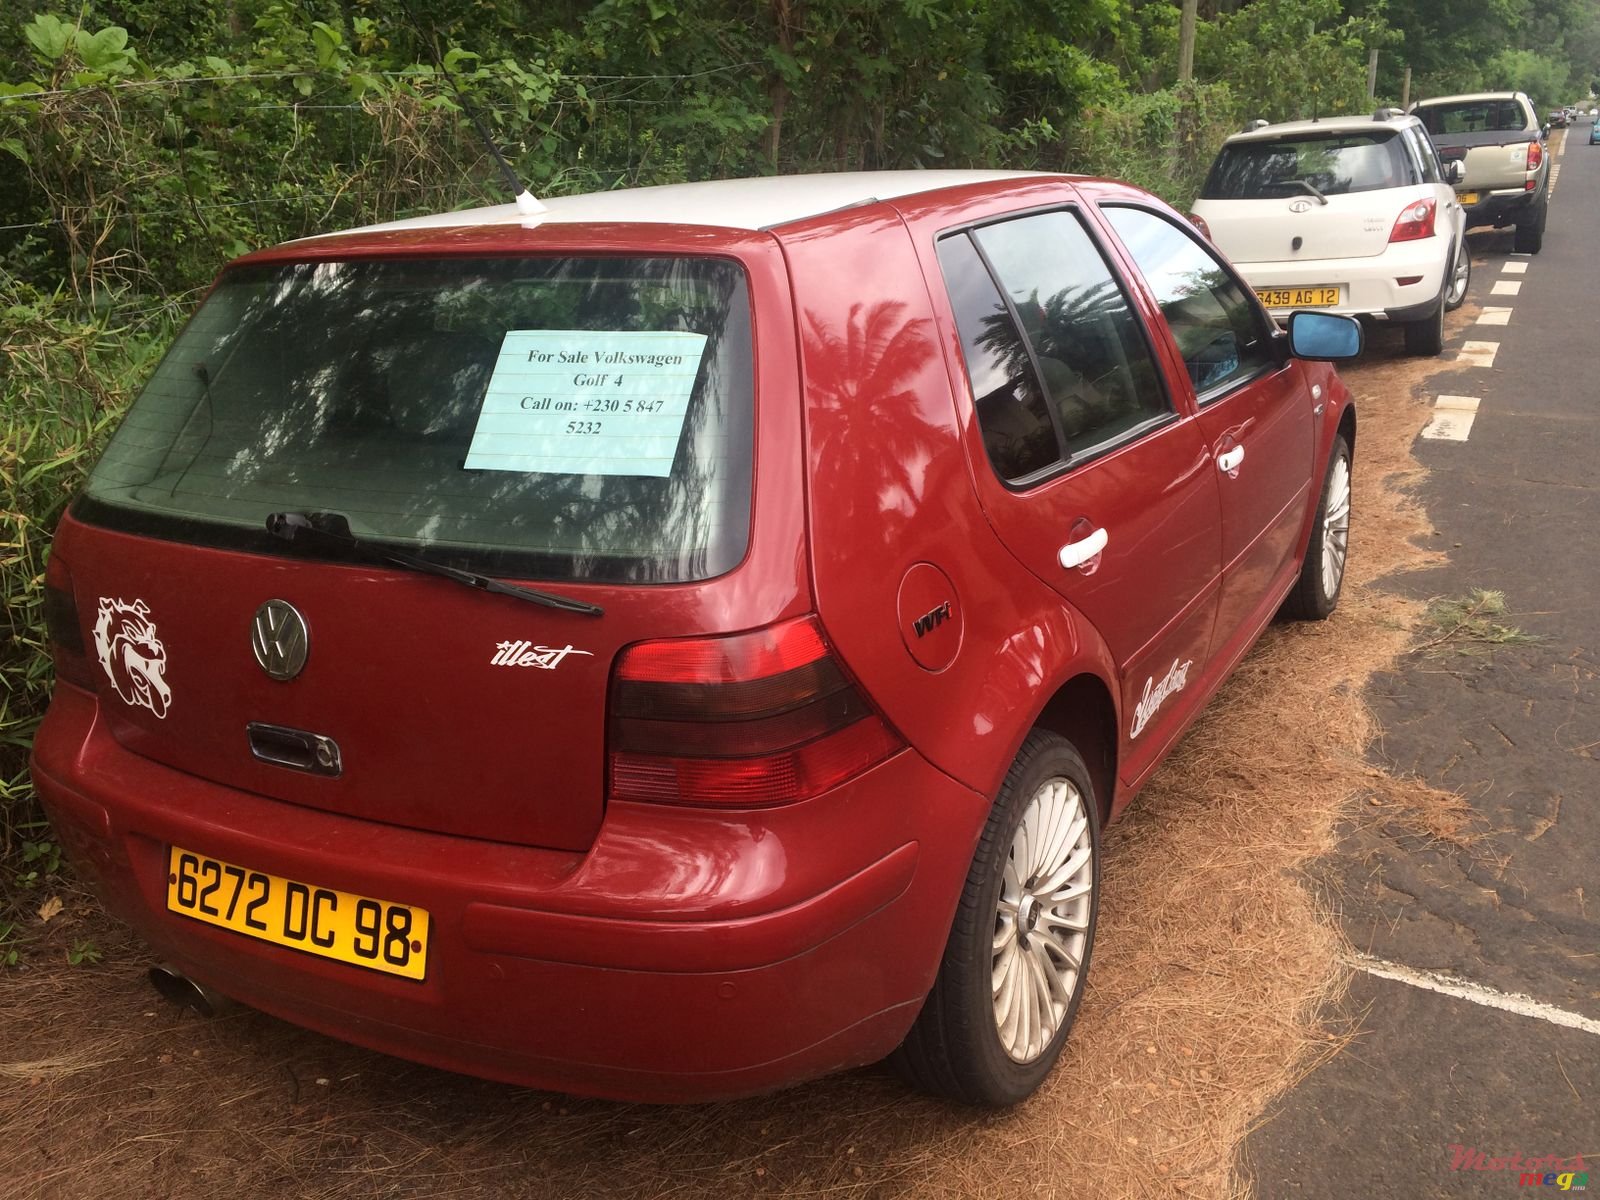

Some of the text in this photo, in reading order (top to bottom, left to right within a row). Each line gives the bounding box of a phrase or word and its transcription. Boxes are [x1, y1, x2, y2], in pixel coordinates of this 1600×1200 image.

[1295, 290, 1313, 304] AG
[1320, 289, 1335, 304] 12
[527, 350, 682, 367] For Sale Volkswagen
[573, 374, 624, 387] Golf 4
[520, 396, 664, 413] Call on: +230 5 847
[566, 421, 602, 435] 5232
[490, 640, 595, 669] illest
[177, 854, 412, 967] 6272 DC 98
